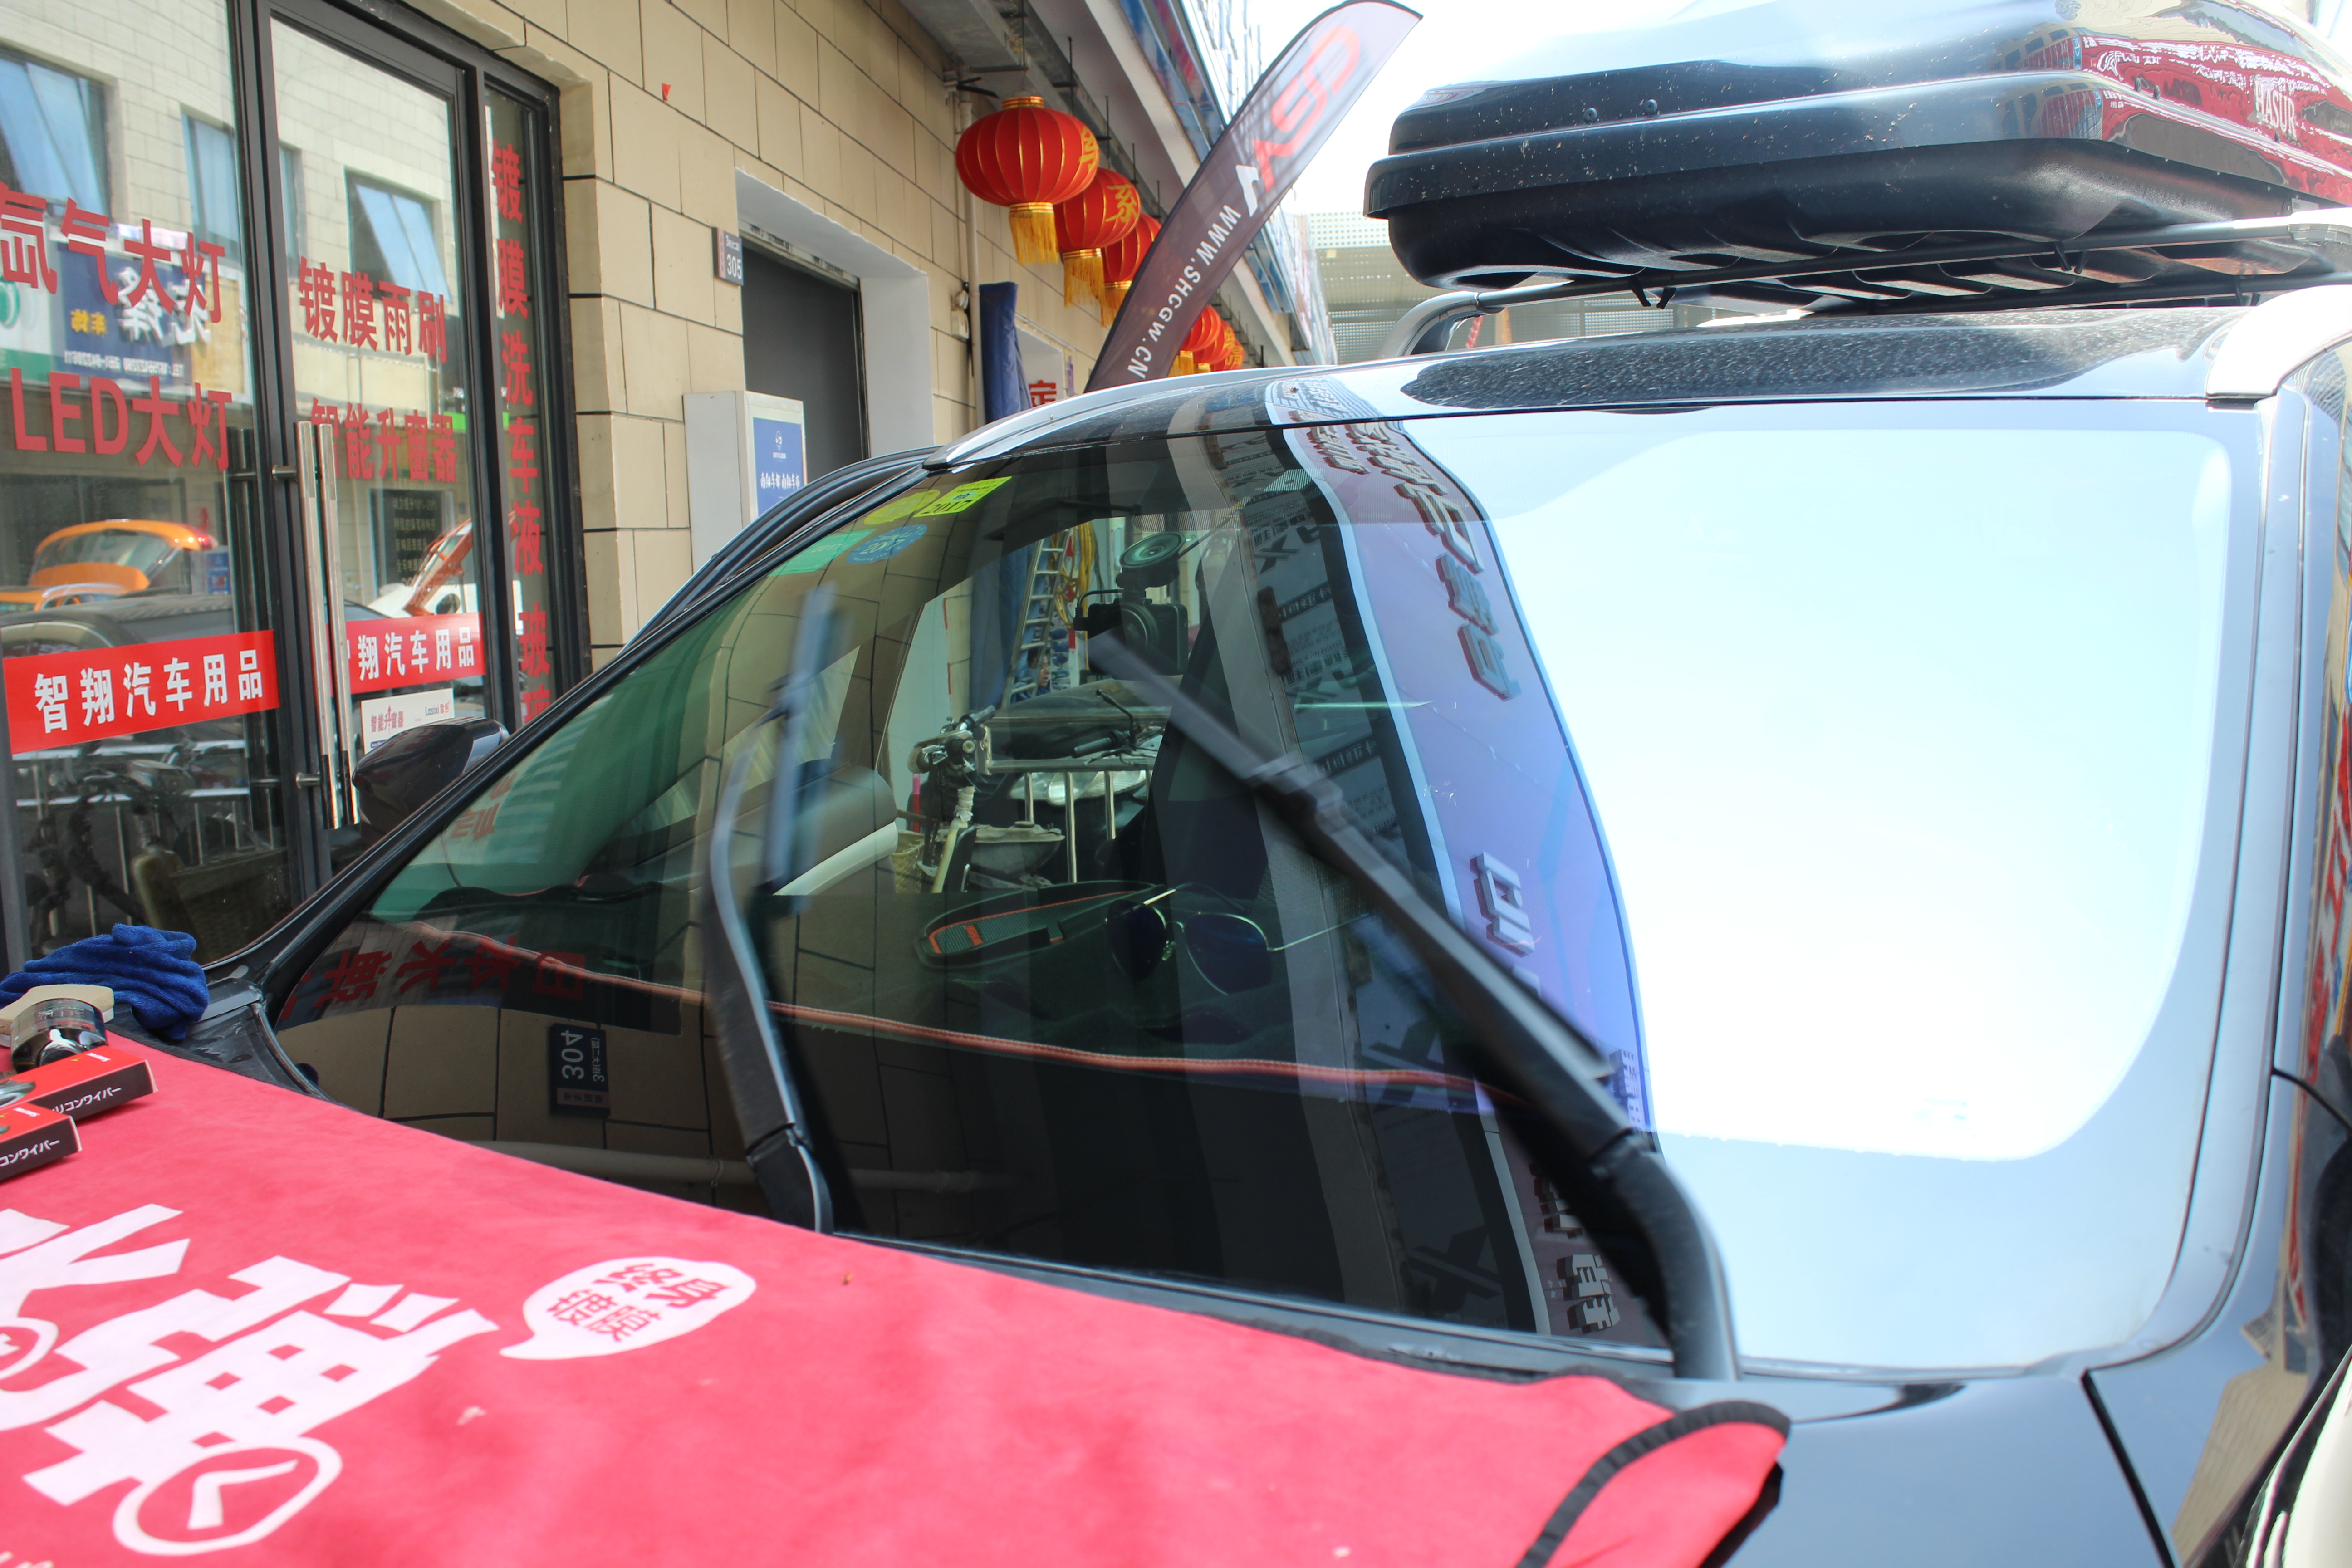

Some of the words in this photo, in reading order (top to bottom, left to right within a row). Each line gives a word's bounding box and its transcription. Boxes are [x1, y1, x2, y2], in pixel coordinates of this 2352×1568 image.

[0, 182, 225, 323] 氙气大灯
[727, 253, 742, 279] 305
[298, 255, 447, 363] 镀膜雨刷
[1127, 204, 1241, 379] WWW.SHCGW.CN
[10, 367, 232, 471] LED大灯
[921, 500, 975, 515] 2017
[859, 538, 906, 555] 2017
[347, 627, 475, 681] 翔汽车用品
[34, 649, 263, 734] 智翔汽车用品
[51, 1086, 122, 1114] リコンワイパー
